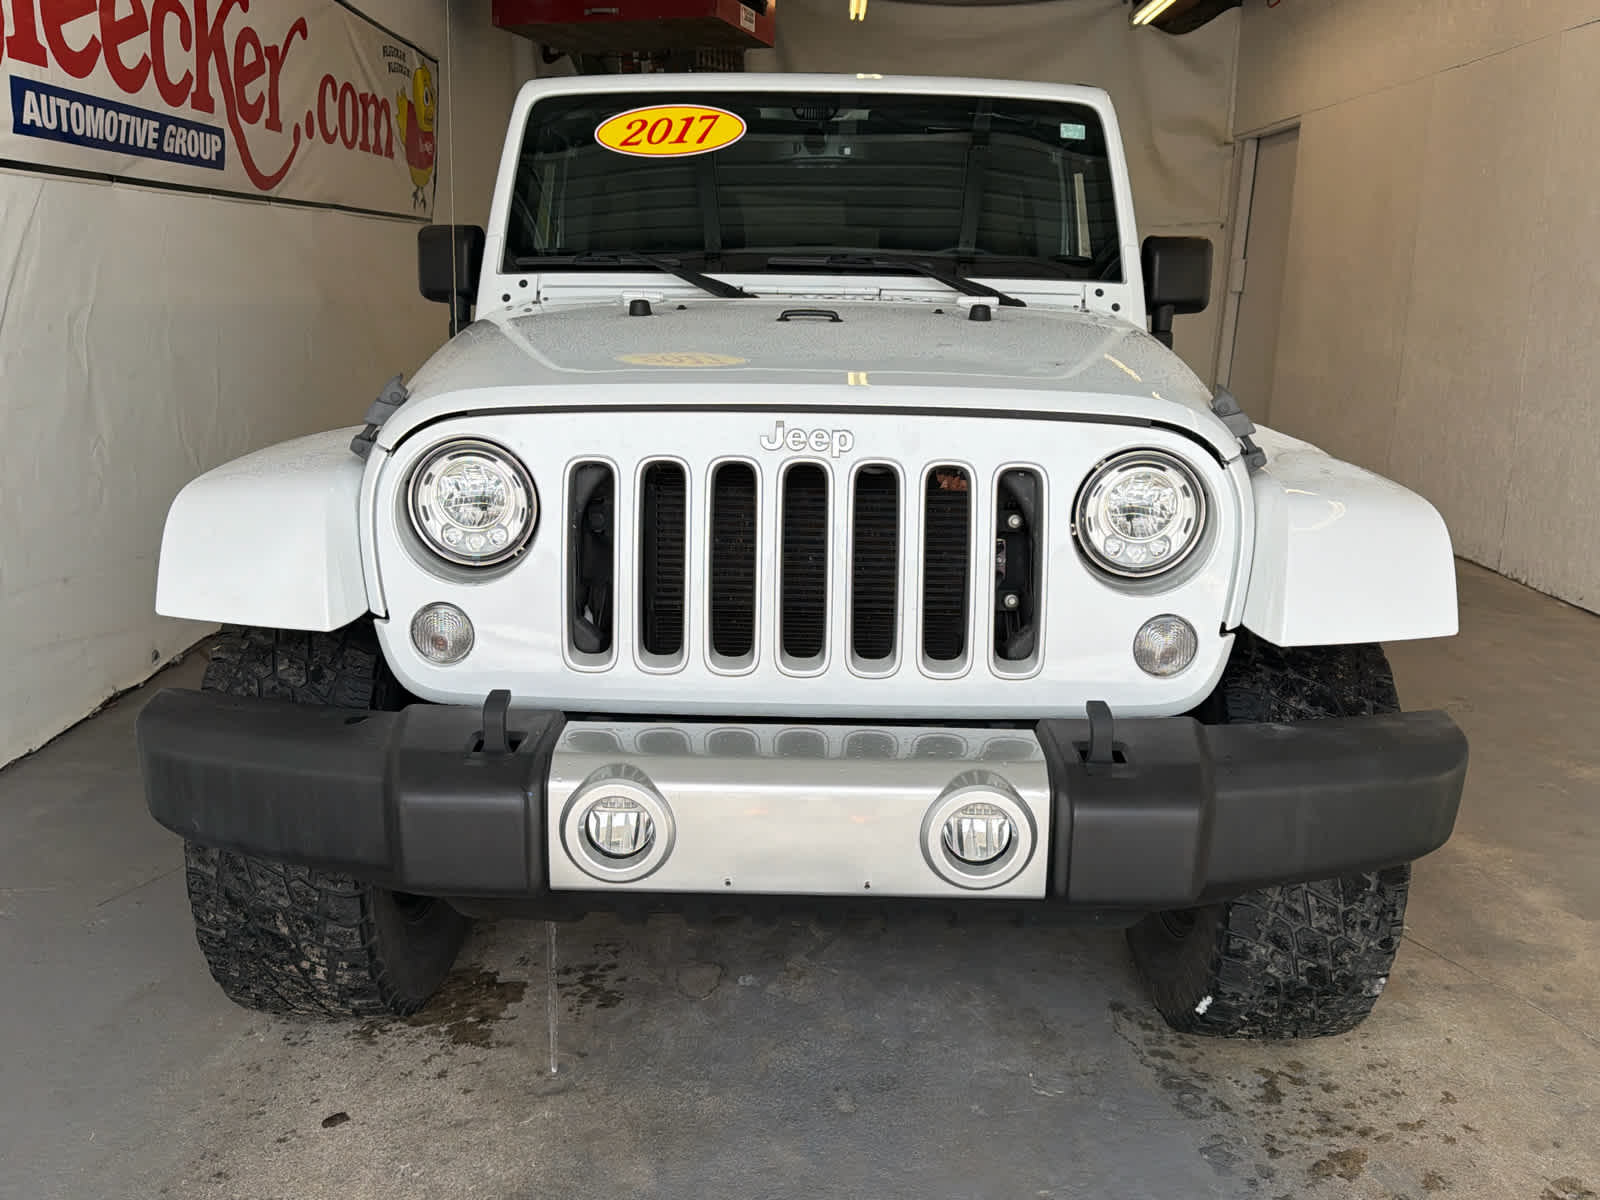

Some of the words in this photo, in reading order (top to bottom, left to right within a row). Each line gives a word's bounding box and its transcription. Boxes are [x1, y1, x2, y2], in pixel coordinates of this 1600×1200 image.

[0, 0, 395, 190] eecker.com
[22, 90, 159, 150] AUTOMOTIVE
[163, 124, 222, 161] GROUP
[619, 114, 720, 147] 2017
[760, 420, 855, 458] Jeep
